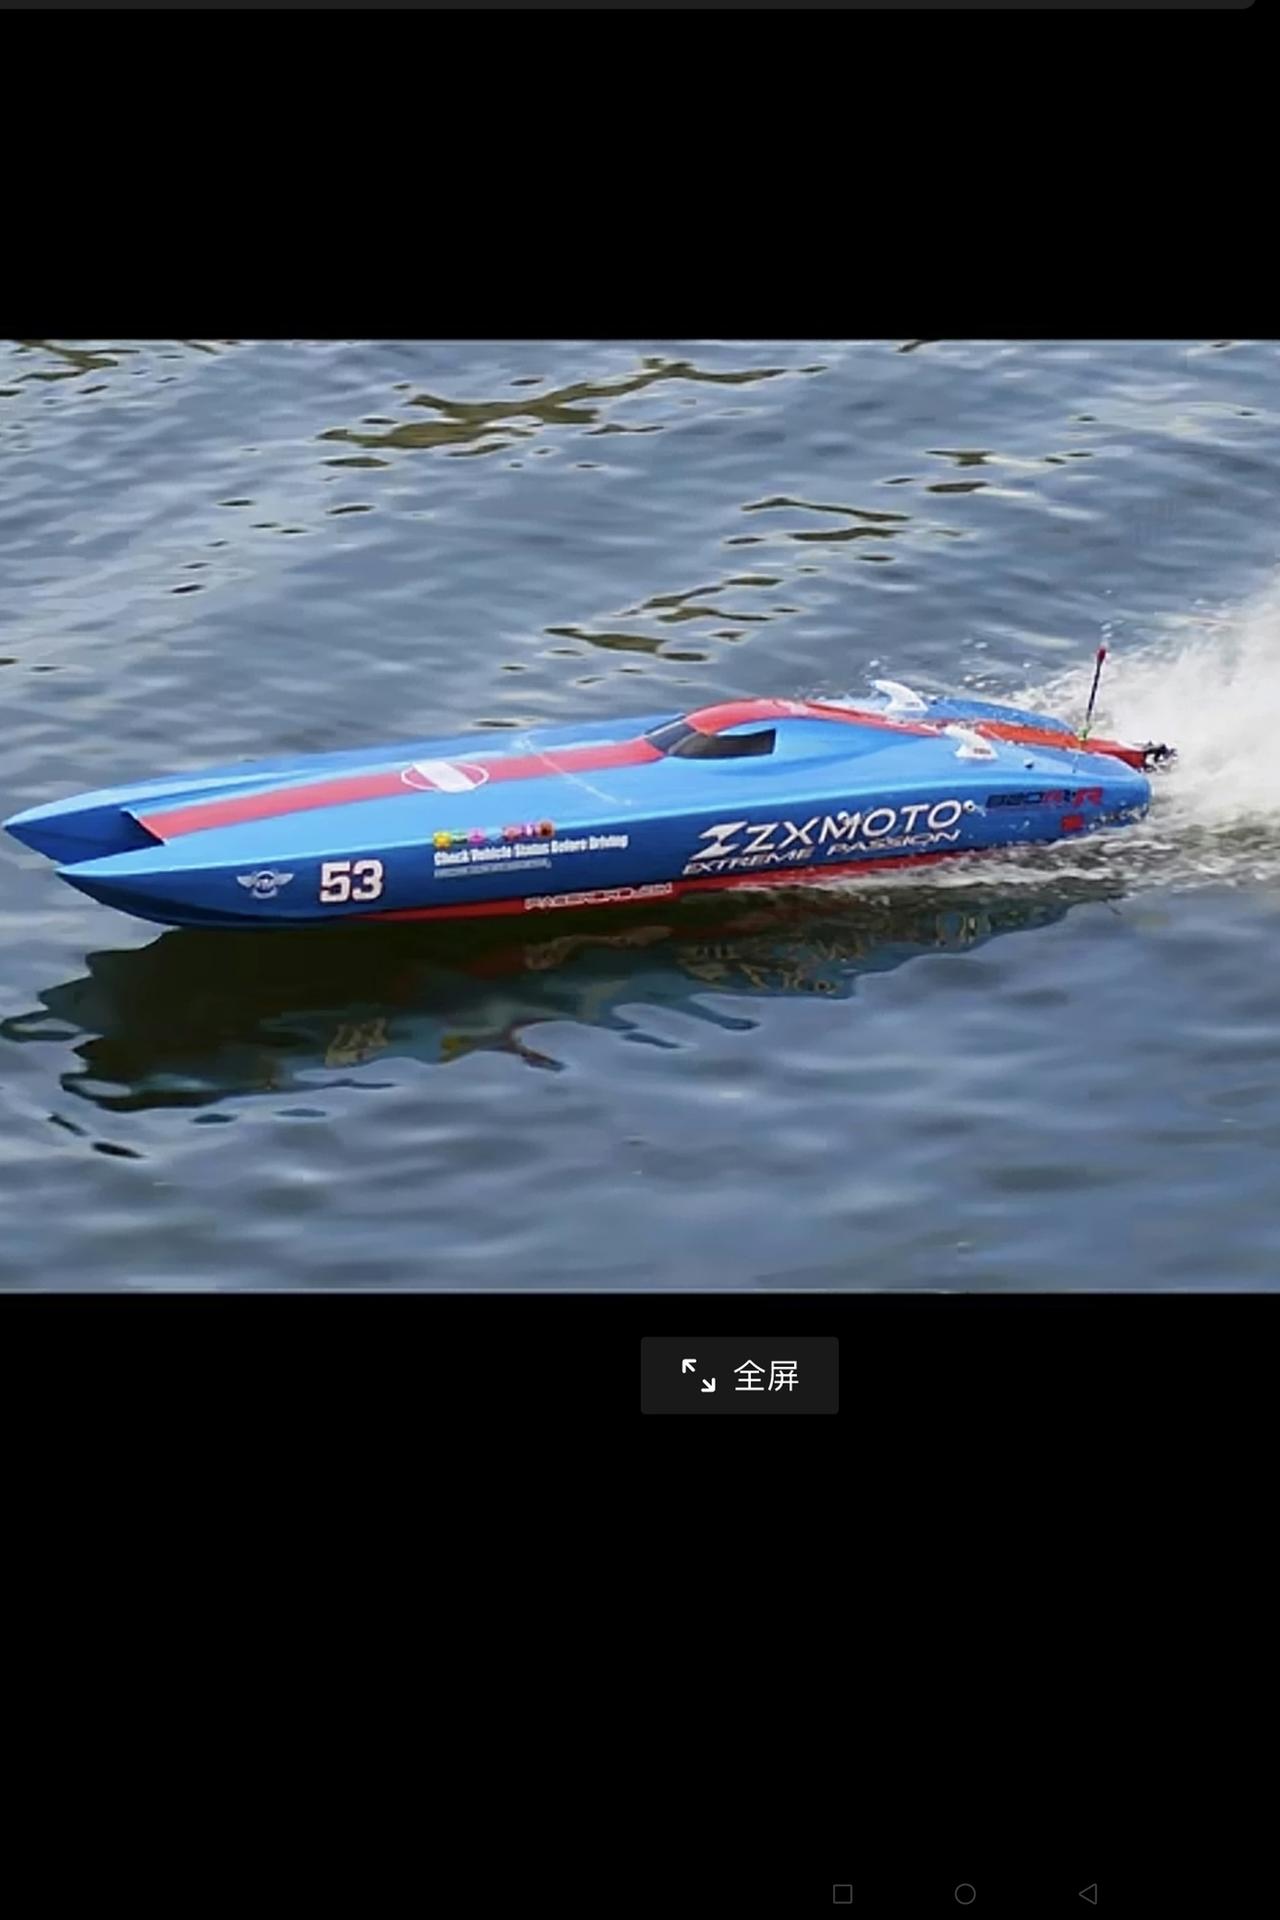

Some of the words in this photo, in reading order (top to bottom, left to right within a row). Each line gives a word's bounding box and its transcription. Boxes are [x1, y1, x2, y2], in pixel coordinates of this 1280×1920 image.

[682, 847, 815, 876] EXTREME
[826, 829, 961, 855] PASSION
[319, 859, 384, 903] 53
